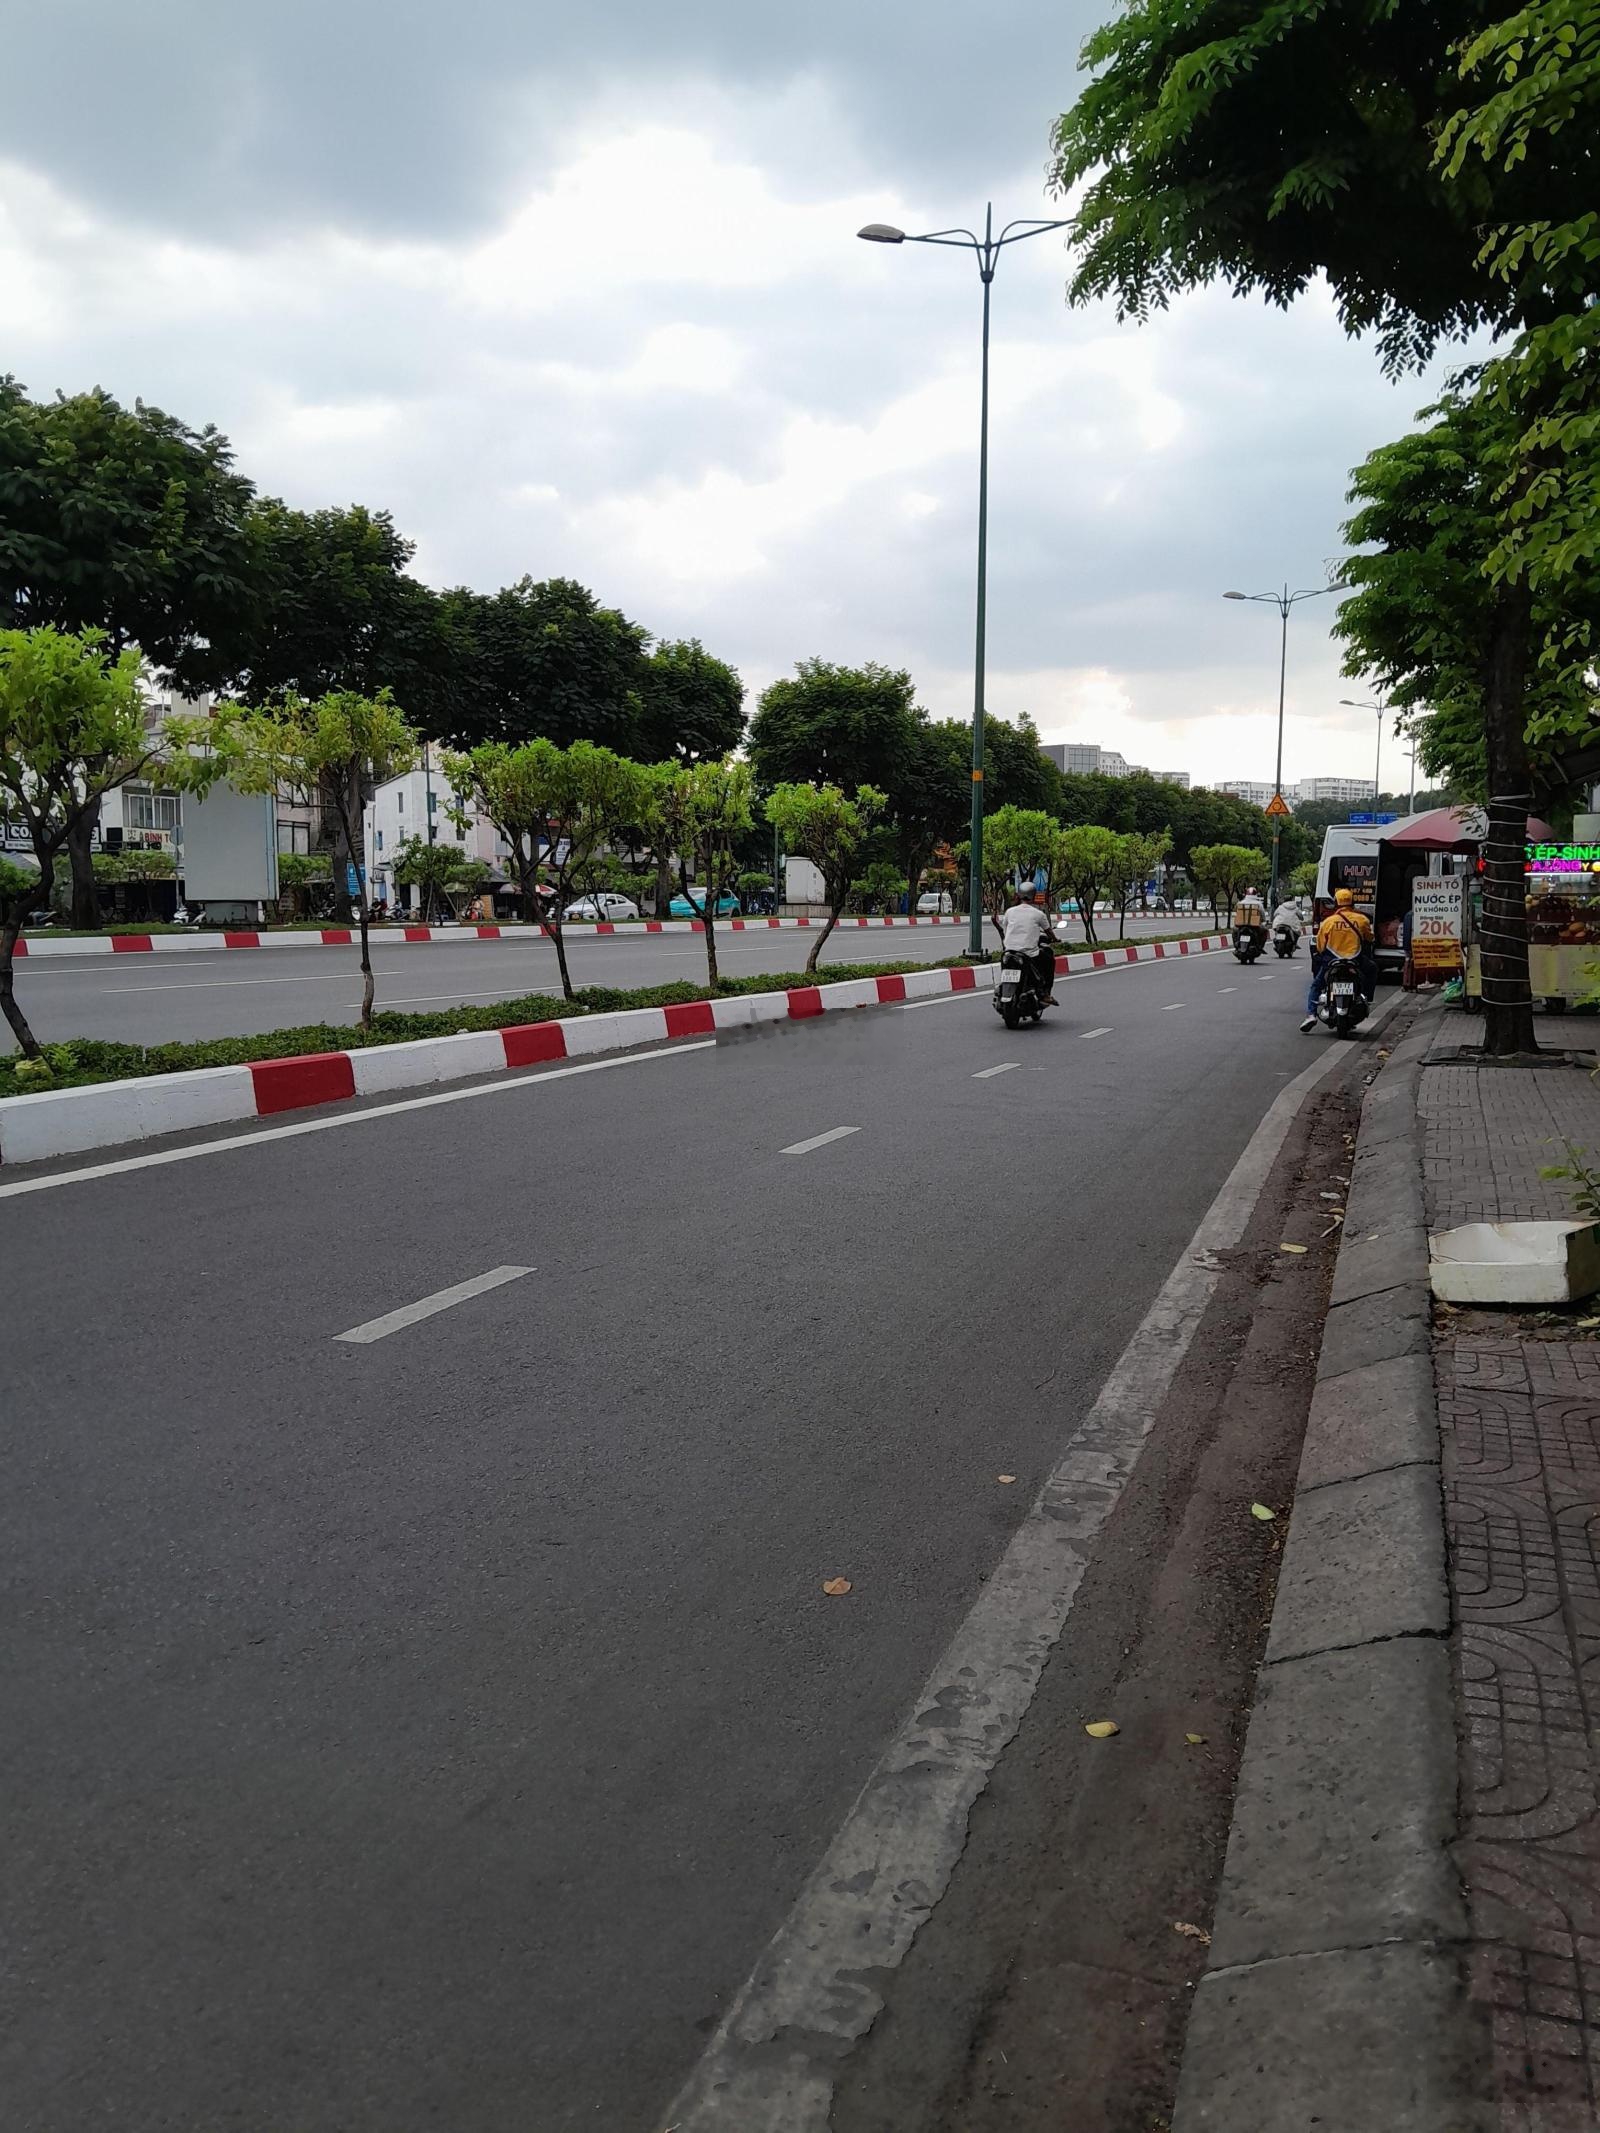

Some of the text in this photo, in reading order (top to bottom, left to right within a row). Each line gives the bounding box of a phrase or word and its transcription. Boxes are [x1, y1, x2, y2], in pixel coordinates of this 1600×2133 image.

[1344, 865, 1374, 876] HUY
[1417, 879, 1460, 890] SINH TỐ
[1414, 893, 1461, 904] NƯỚC ÉP
[1420, 920, 1455, 936] 20K
